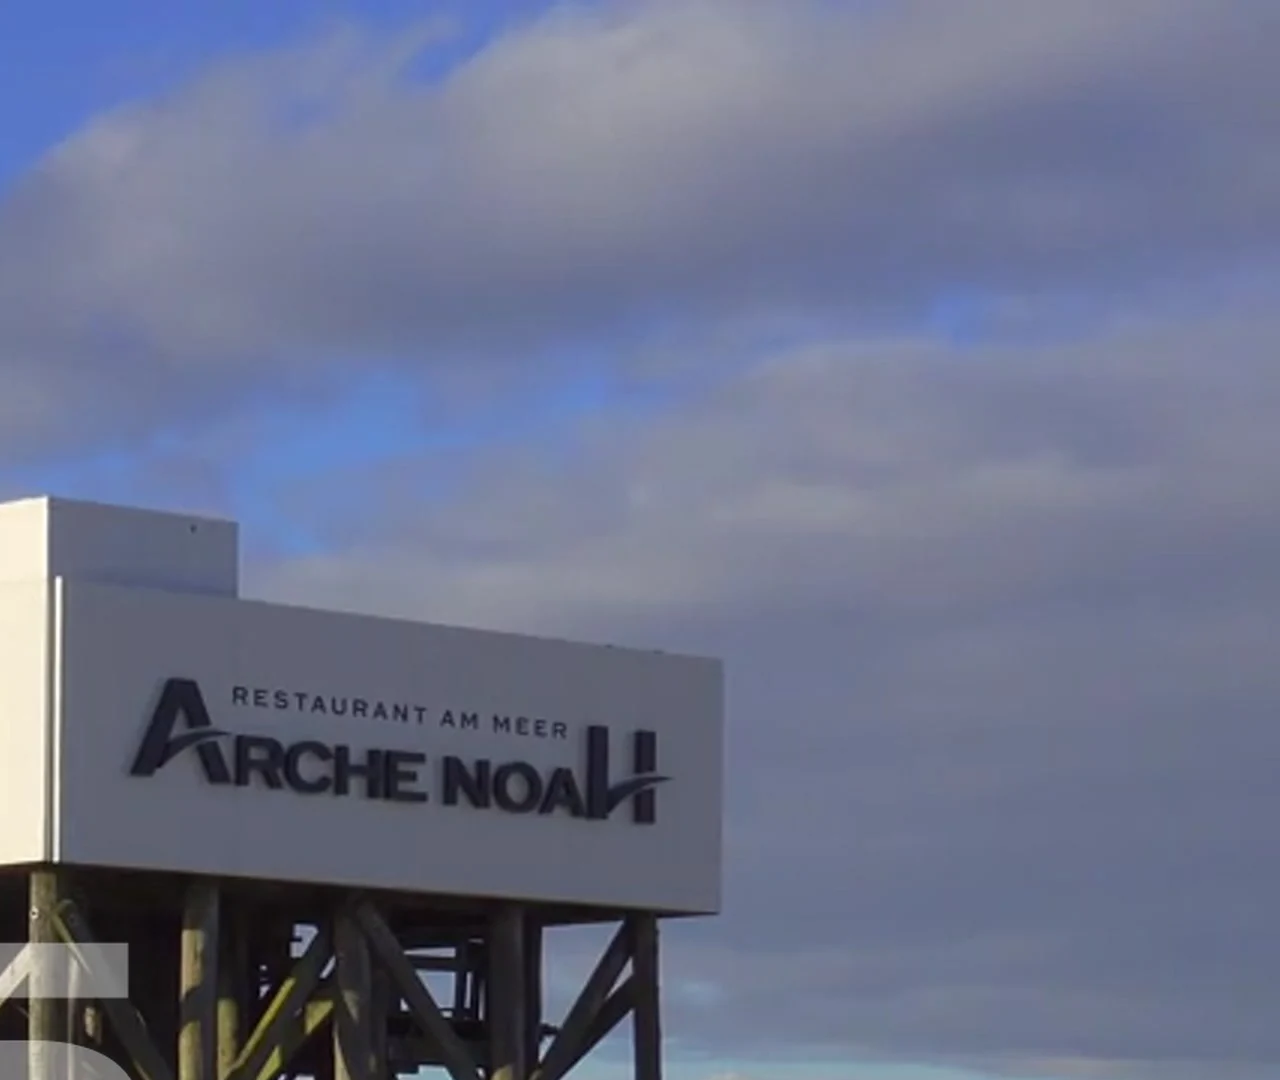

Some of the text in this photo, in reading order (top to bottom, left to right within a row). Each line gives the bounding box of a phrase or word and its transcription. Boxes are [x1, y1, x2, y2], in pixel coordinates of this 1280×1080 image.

[129, 677, 673, 825] ARCHE NOAH
[232, 685, 568, 740] RESTAURANT AM MEER
